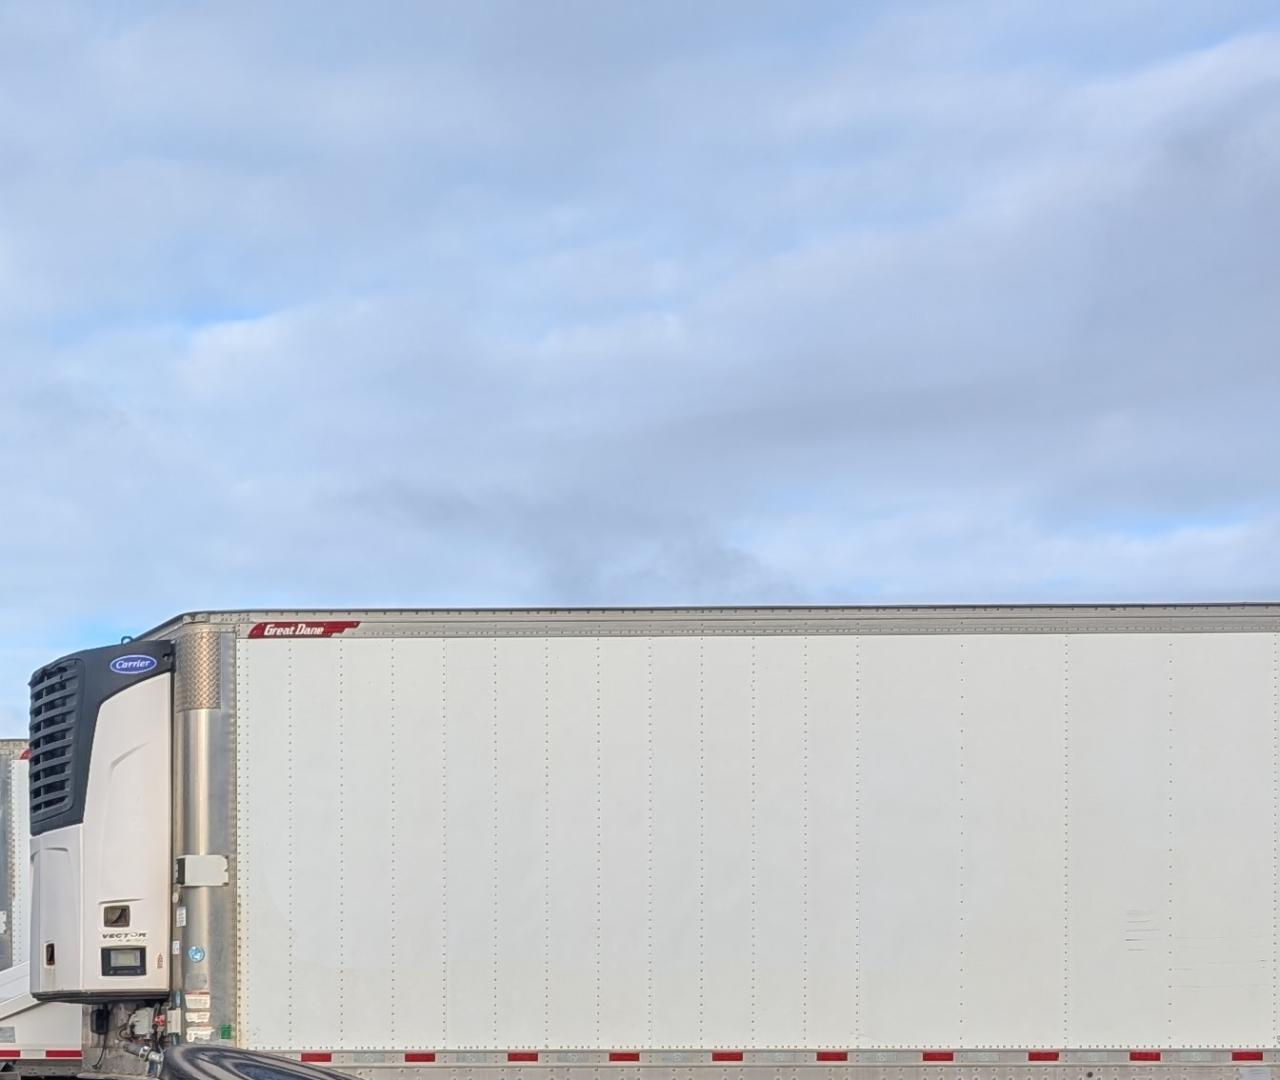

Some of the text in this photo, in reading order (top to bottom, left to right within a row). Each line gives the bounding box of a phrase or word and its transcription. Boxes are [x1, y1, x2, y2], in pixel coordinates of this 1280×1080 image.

[264, 623, 324, 636] Great Dane
[116, 659, 151, 669] Carrier
